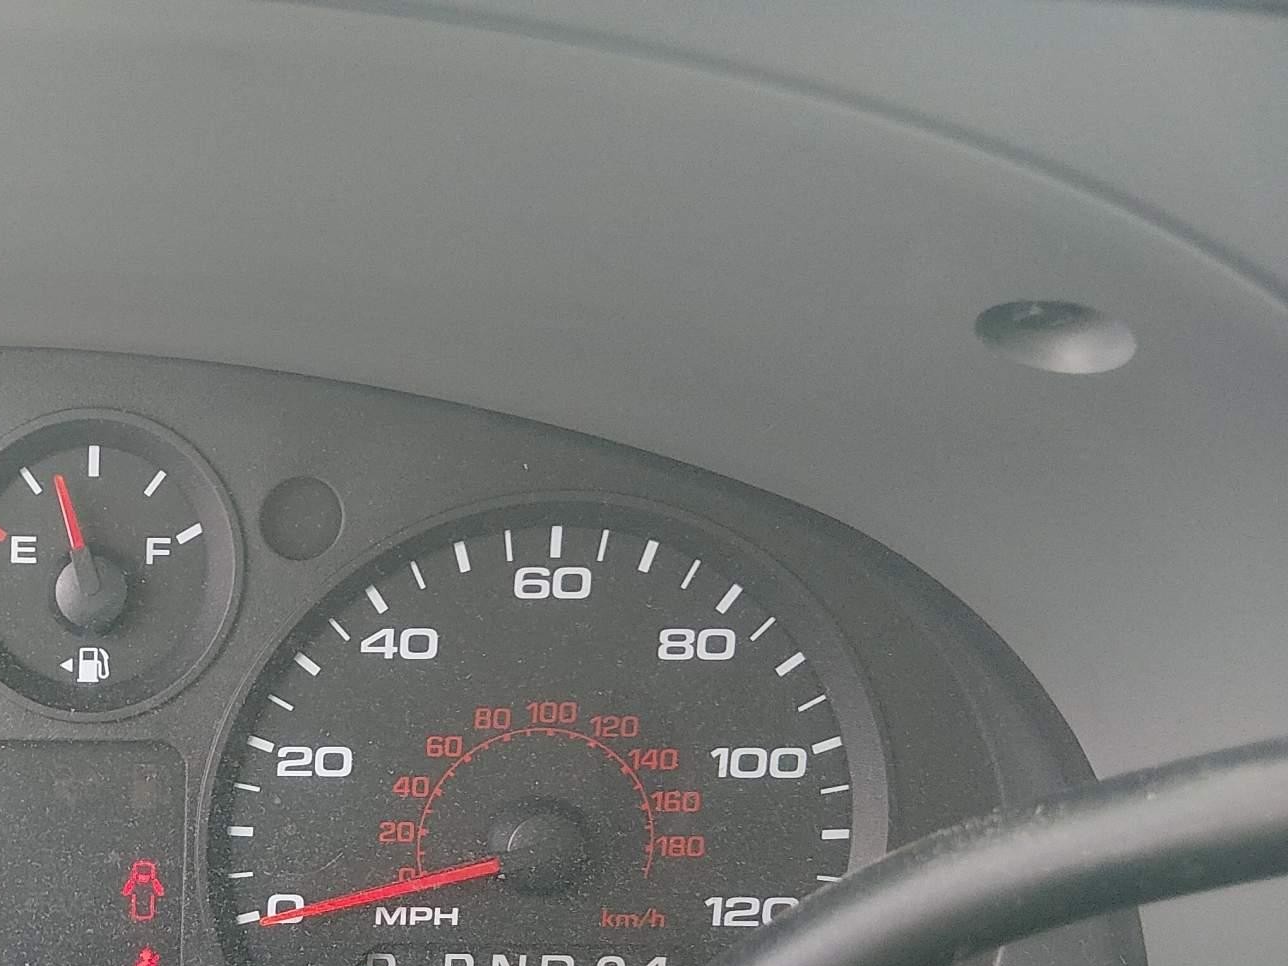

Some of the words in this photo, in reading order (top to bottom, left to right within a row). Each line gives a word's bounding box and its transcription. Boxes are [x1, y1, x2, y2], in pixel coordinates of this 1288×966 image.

[12, 536, 37, 564] E
[146, 537, 170, 564] F
[514, 567, 592, 599] 60
[361, 628, 439, 659] 40
[658, 629, 736, 660] 80
[474, 708, 511, 729] 80
[527, 702, 577, 724] 100
[590, 716, 639, 737] 120
[426, 736, 463, 757] 60
[277, 747, 353, 777] 20
[628, 749, 679, 770] 140
[711, 748, 806, 778] 100
[392, 777, 430, 797] 40
[651, 792, 701, 812] 160
[379, 821, 415, 842] 20
[656, 836, 705, 857] 180
[267, 895, 304, 924] 0
[374, 907, 459, 926] MPH
[601, 908, 665, 928] km/h
